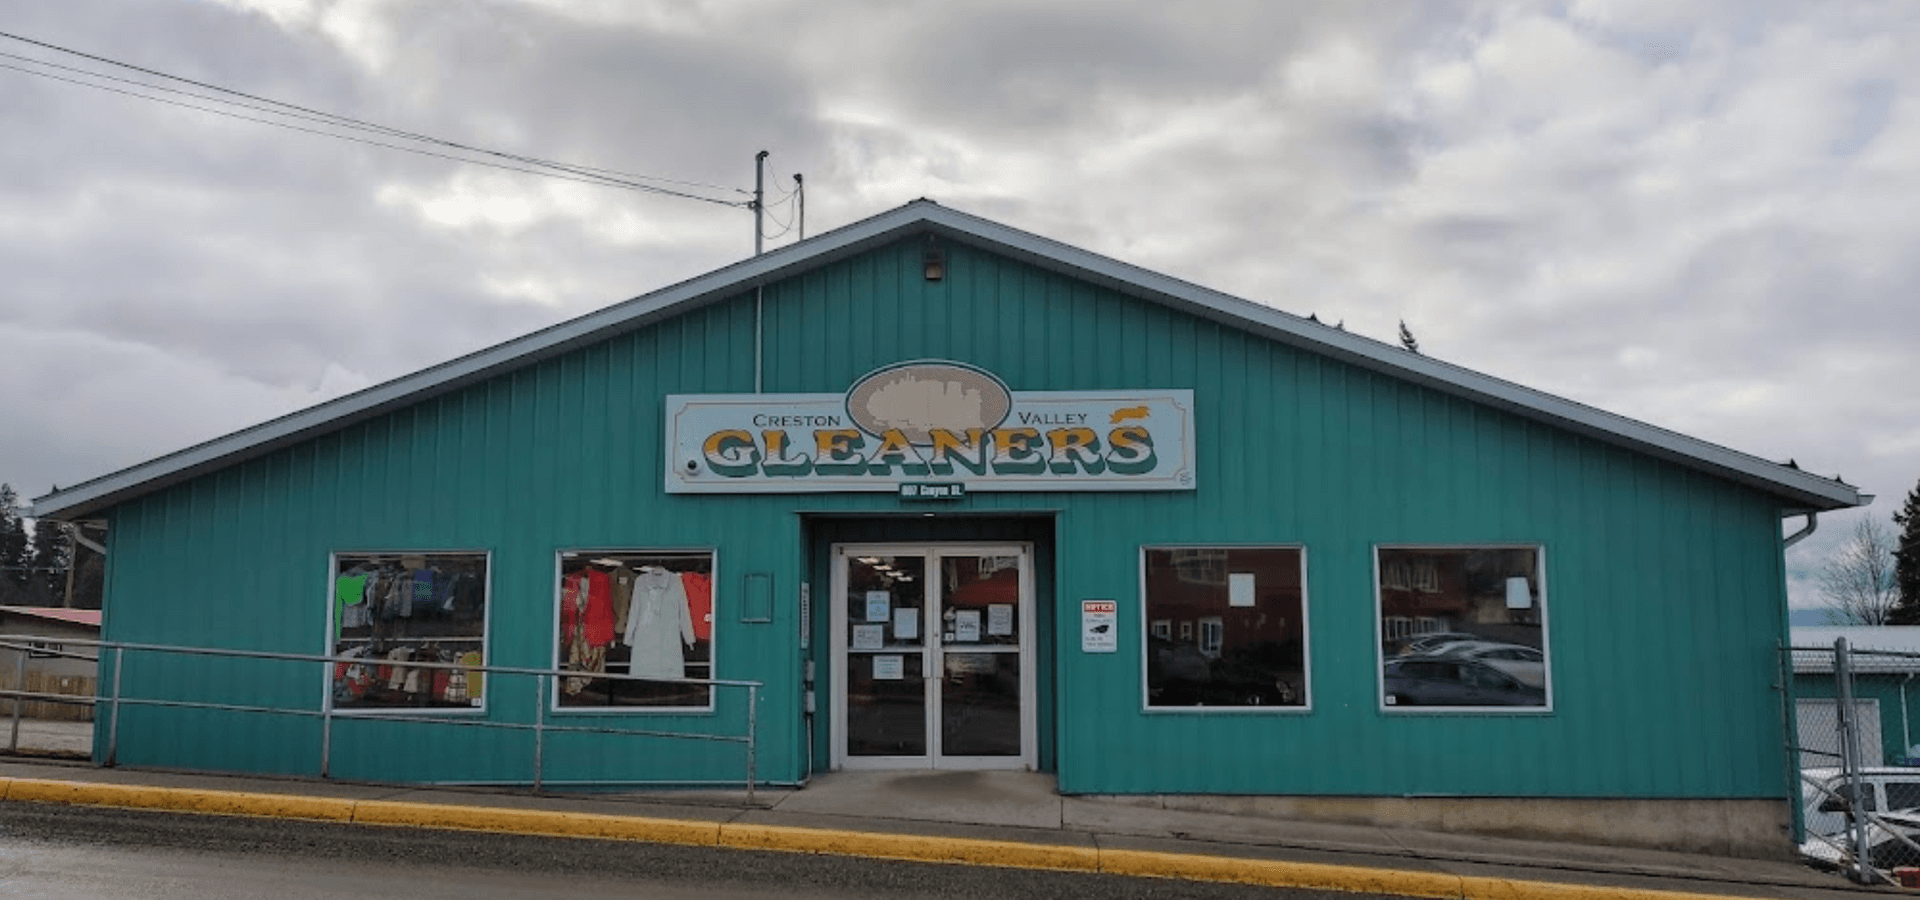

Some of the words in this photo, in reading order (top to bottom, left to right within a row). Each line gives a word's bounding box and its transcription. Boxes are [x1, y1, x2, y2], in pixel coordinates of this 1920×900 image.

[753, 413, 841, 427] CRESTON
[1018, 412, 1088, 425] VALLEY
[702, 427, 1158, 477] GLEANERS
